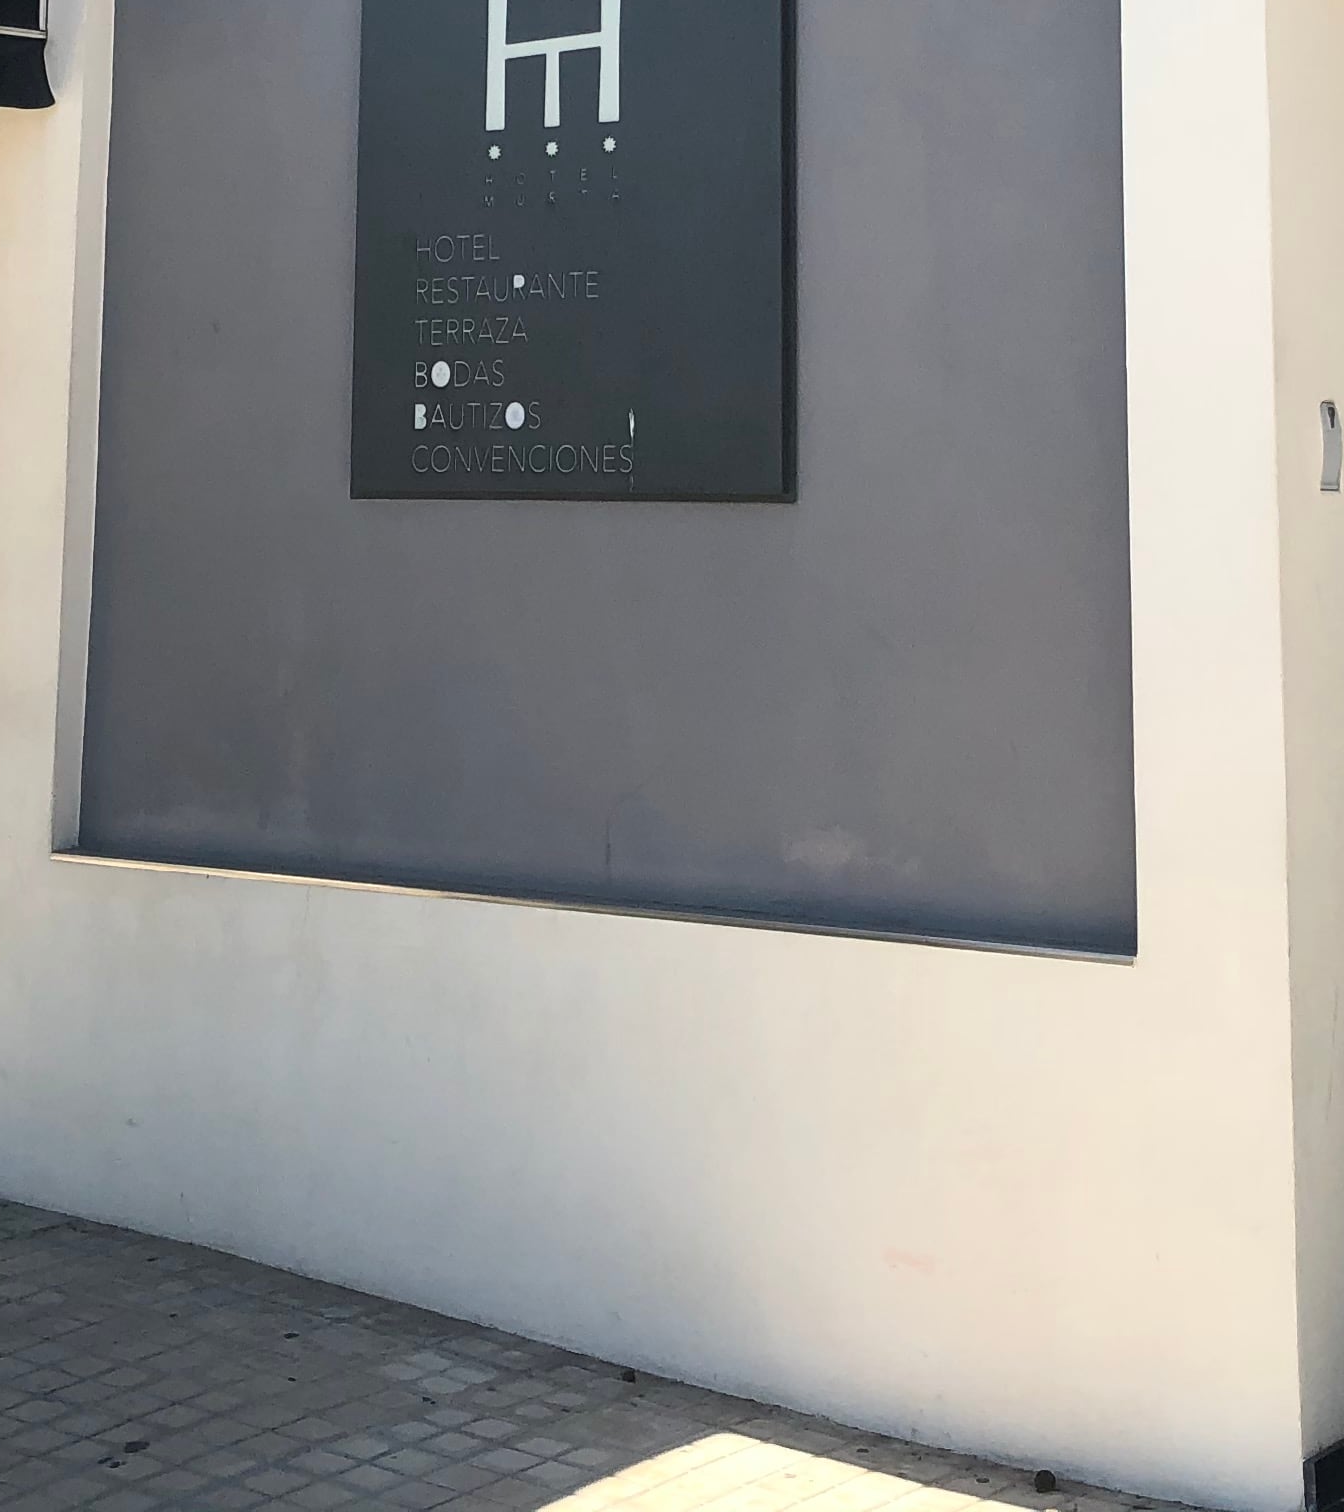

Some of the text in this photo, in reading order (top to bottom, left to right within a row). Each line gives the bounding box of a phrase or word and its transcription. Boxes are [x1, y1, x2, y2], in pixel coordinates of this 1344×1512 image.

[416, 234, 500, 262] HOTEL
[416, 271, 599, 305] RESTAURANTE
[415, 317, 528, 346] TERRAZA
[415, 359, 505, 388] BODAS
[413, 401, 542, 430] BAUTIZOS
[412, 444, 633, 473] CONVENCIONES
